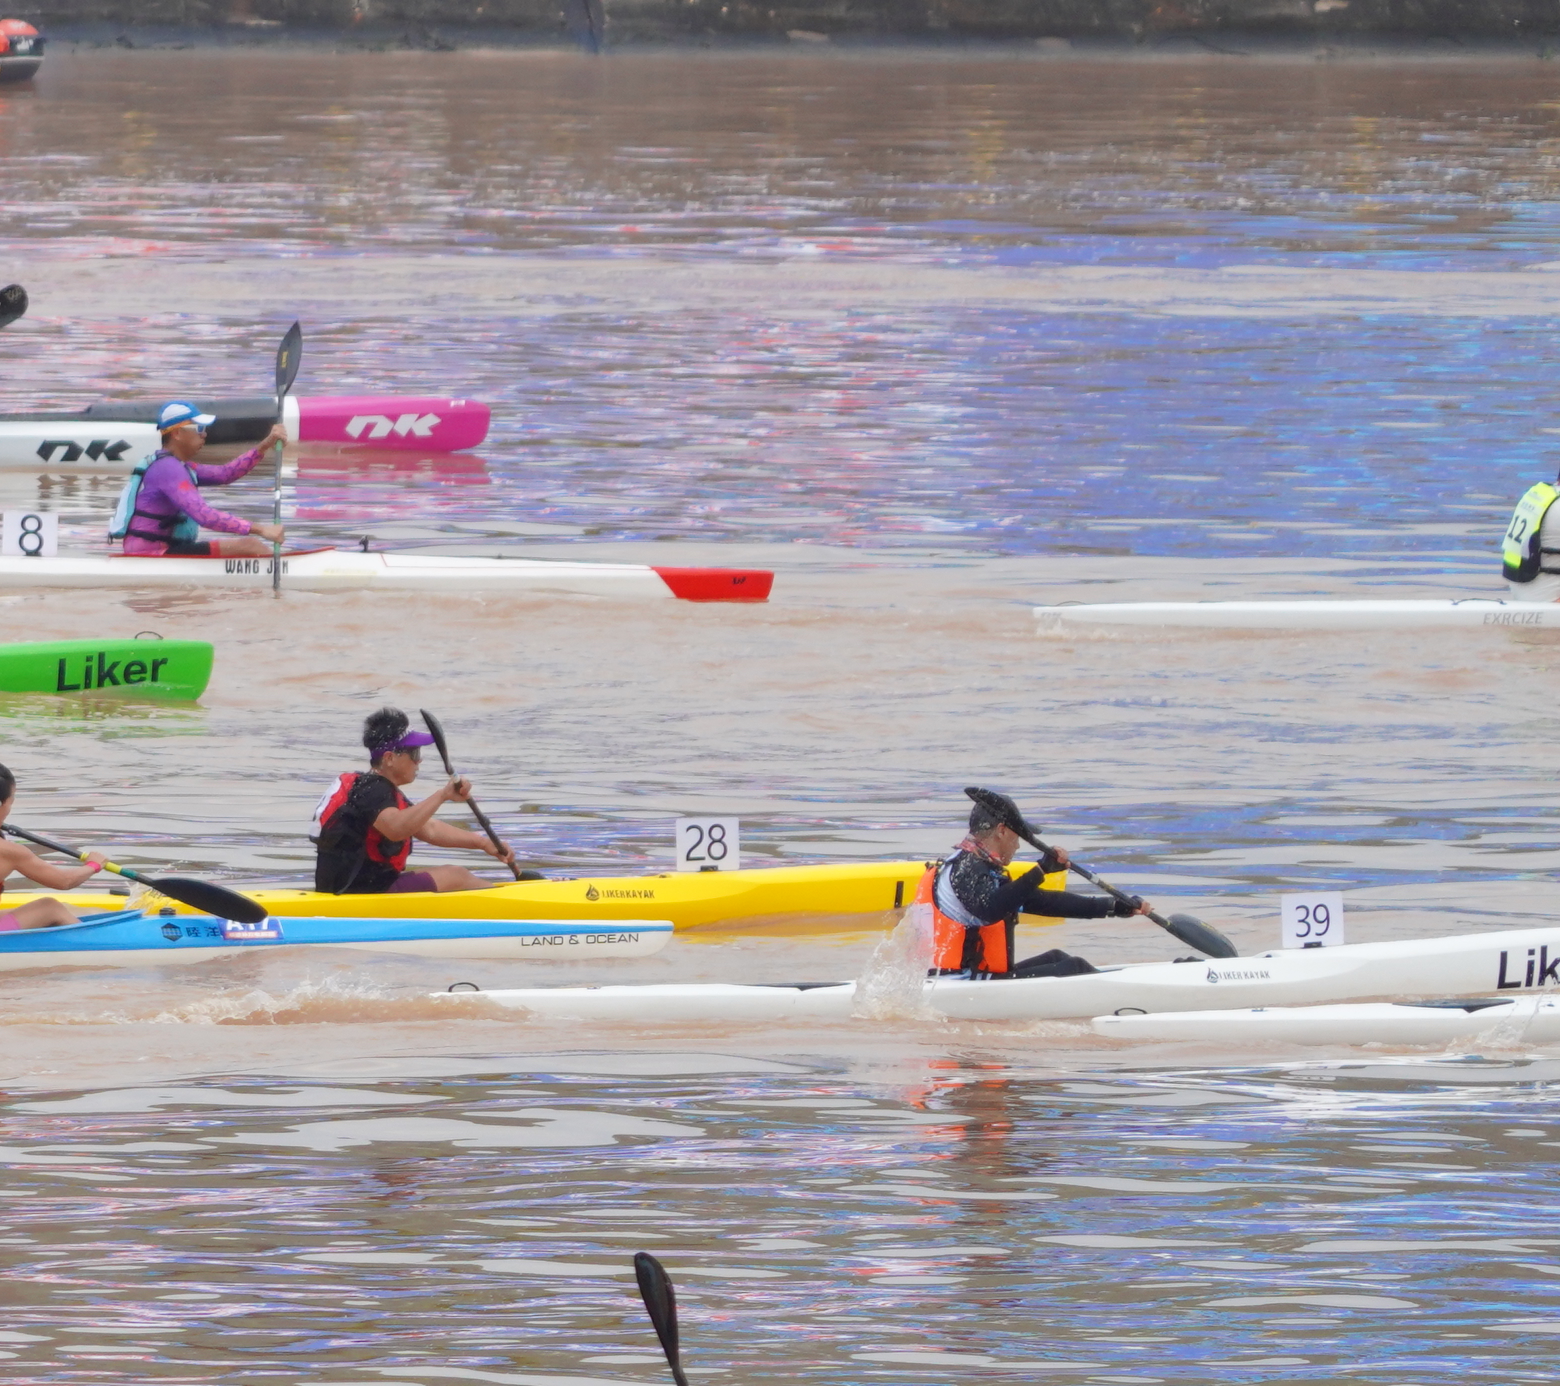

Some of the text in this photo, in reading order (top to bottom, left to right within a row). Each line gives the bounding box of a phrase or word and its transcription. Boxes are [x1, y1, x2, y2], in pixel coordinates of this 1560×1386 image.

[18, 513, 44, 554] 8
[266, 559, 289, 574] JN
[56, 651, 169, 693] Liker
[685, 823, 728, 862] 28
[1294, 903, 1331, 938] 39
[521, 934, 639, 947] LAND & OCEAN
